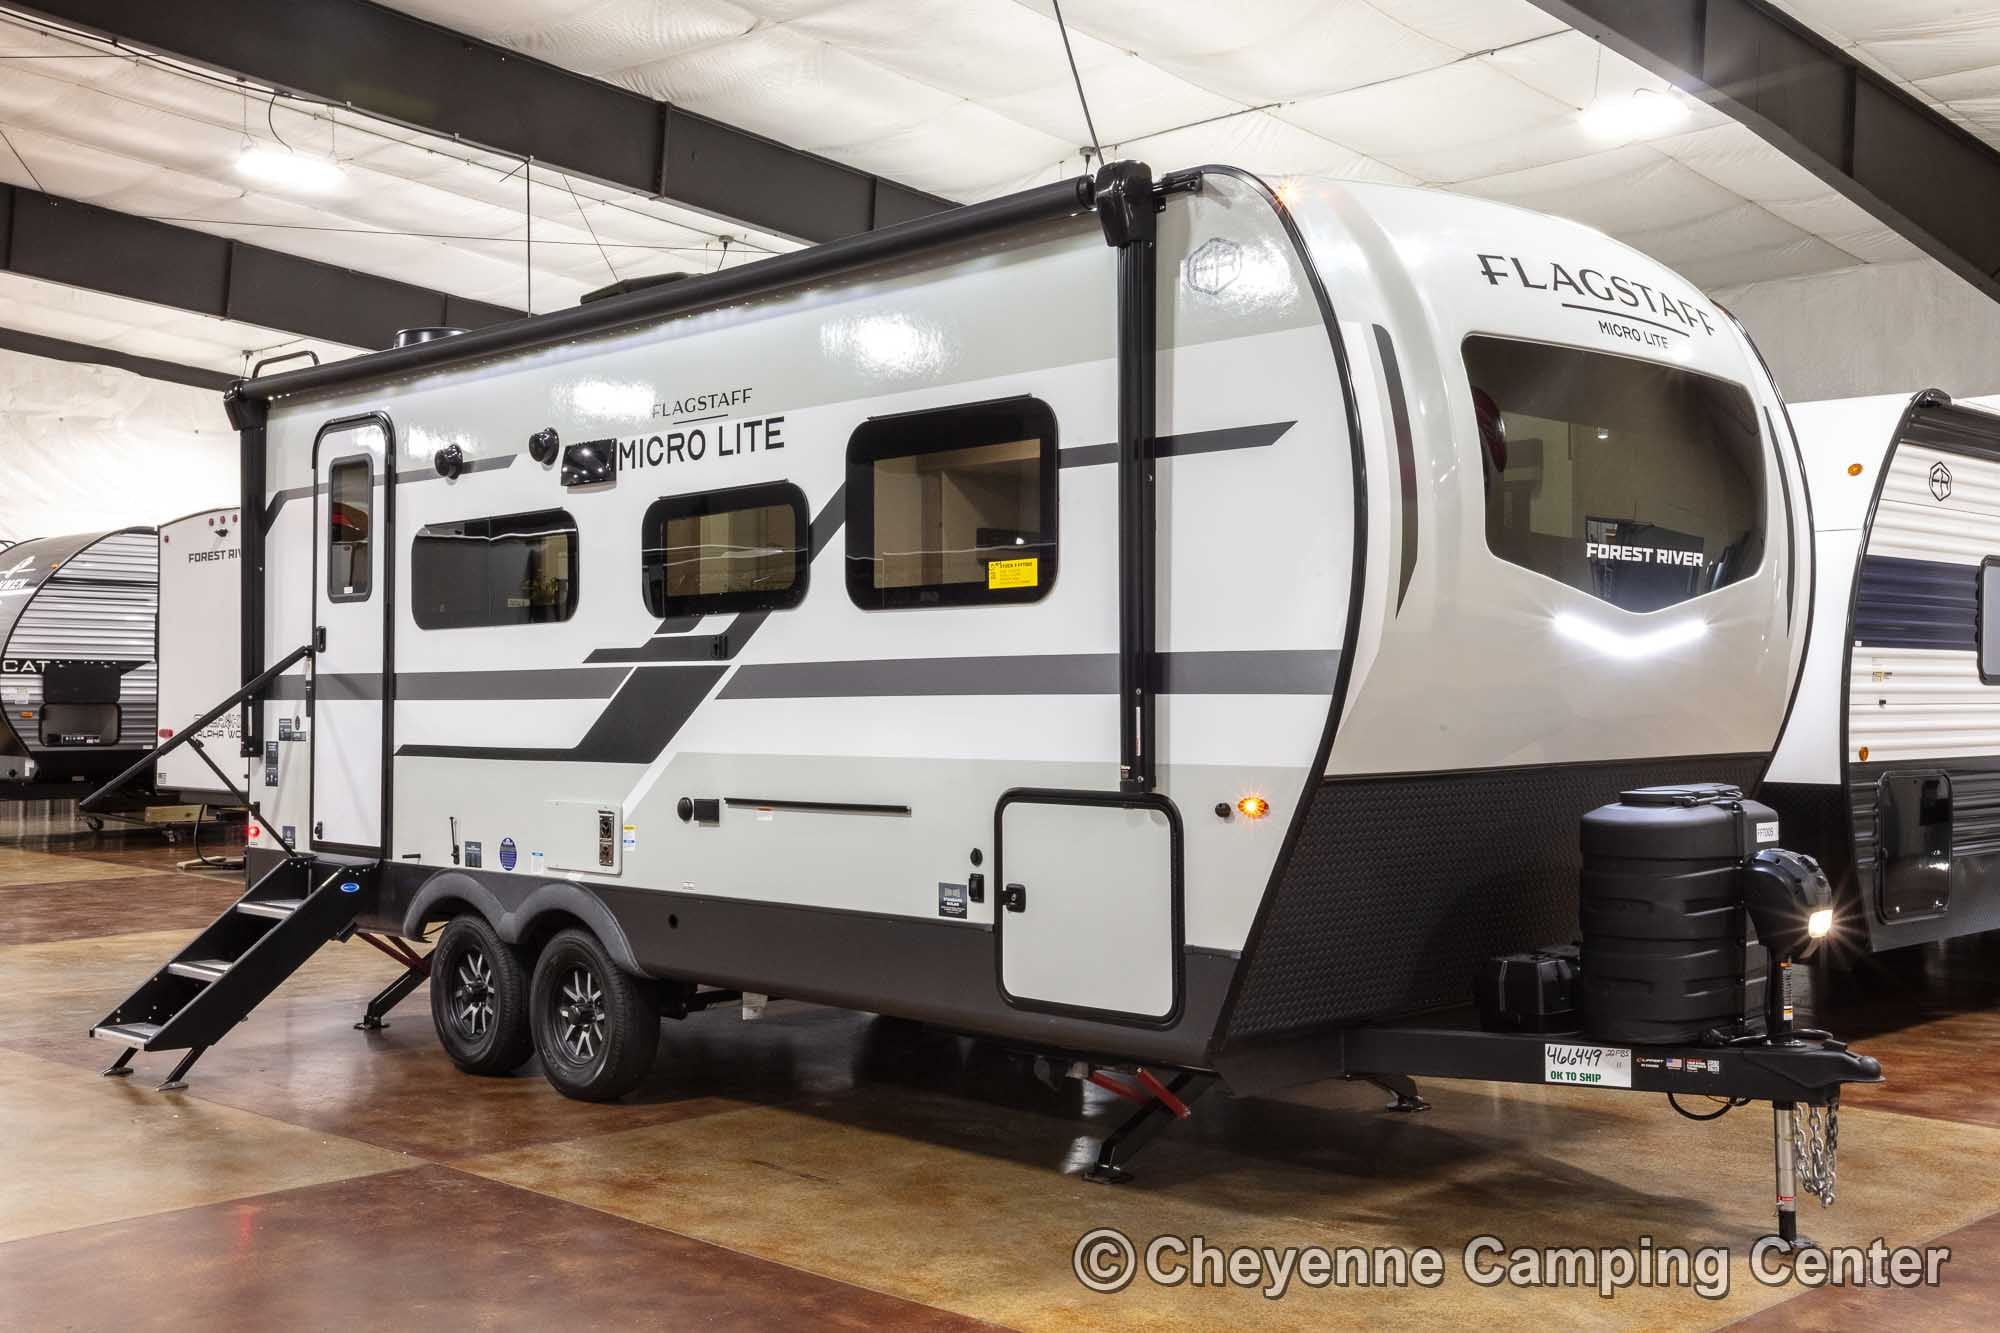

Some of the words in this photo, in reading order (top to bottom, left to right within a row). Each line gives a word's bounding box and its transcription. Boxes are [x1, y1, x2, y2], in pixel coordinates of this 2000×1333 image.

[1477, 253, 1716, 337] FLAGSTAFF
[1598, 320, 1641, 342] MICRO
[1643, 332, 1669, 349] LITE
[651, 387, 754, 419] FLAGSTAFF
[618, 429, 707, 472] MICRO
[718, 415, 786, 457] LITE
[187, 550, 227, 564] FOREST
[1585, 542, 1654, 564] FOREST
[1656, 548, 1705, 568] RIVER
[195, 729, 224, 739] ALPHA
[1546, 1046, 1602, 1068] 466449
[1550, 1071, 1563, 1081] OK
[1566, 1072, 1577, 1081] TO
[1579, 1072, 1601, 1083] SHIP
